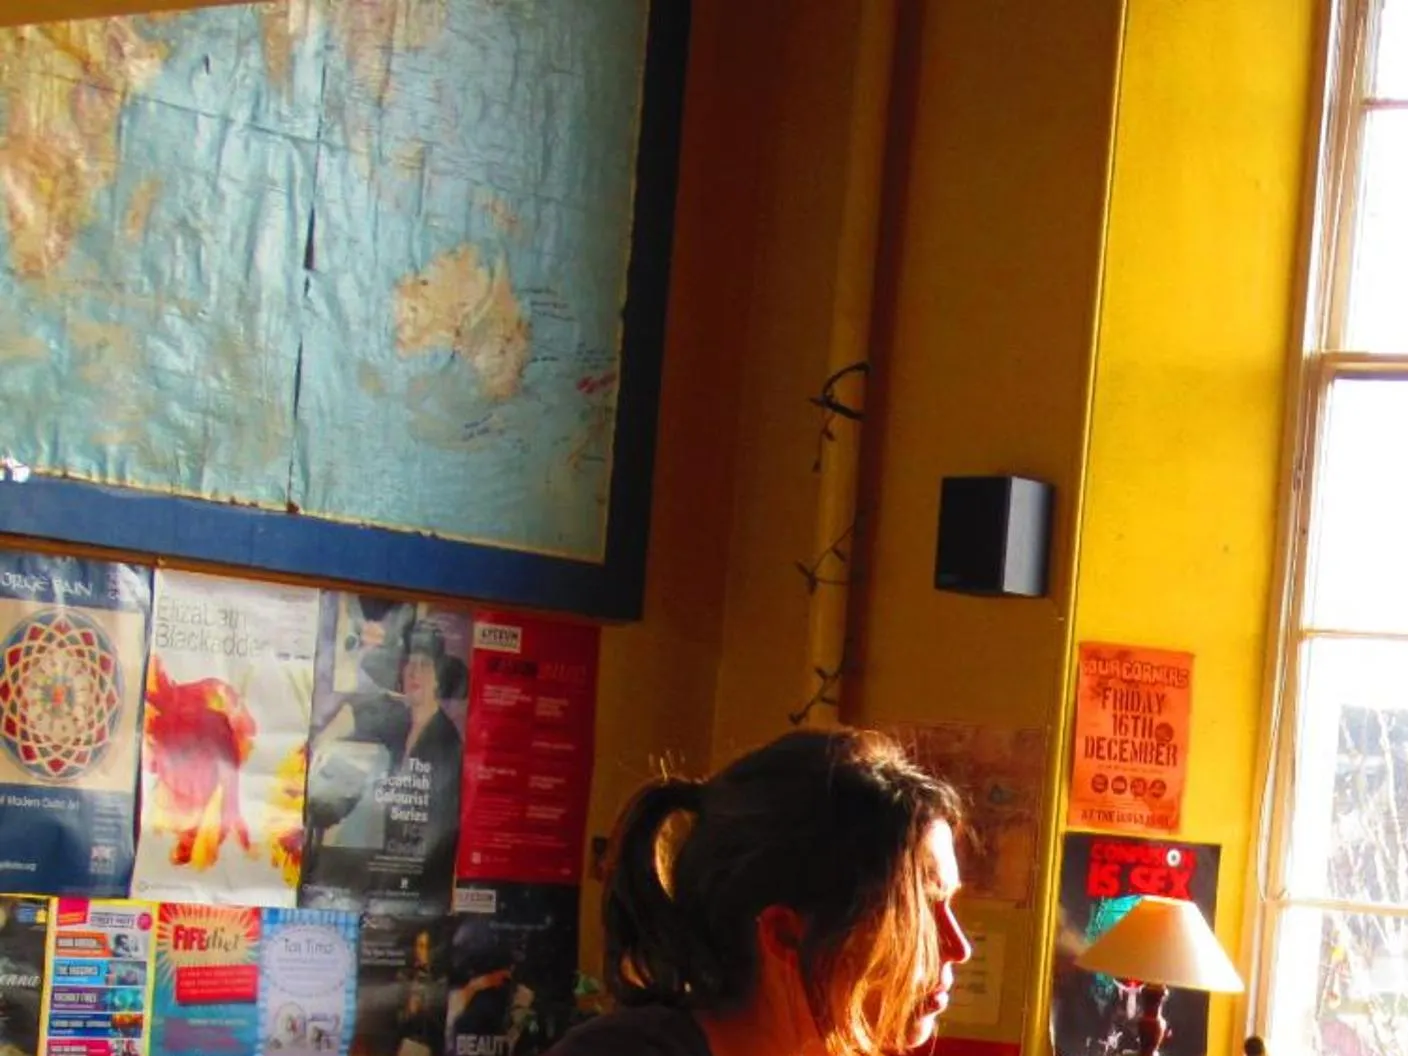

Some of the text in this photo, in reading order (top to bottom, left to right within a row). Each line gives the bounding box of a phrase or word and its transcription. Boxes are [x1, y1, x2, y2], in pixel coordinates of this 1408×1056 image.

[1100, 686, 1165, 717] FRIDAY
[1111, 713, 1154, 739] 16TH
[1084, 735, 1179, 768] DECEMBER
[409, 758, 432, 773] The
[380, 774, 430, 790] Scottish
[374, 788, 430, 807] Colourist
[390, 806, 429, 822] Series
[1091, 843, 1197, 868] CONFUSION
[1087, 864, 1192, 901] IS SEX
[456, 1032, 512, 1056] BEAUTY
